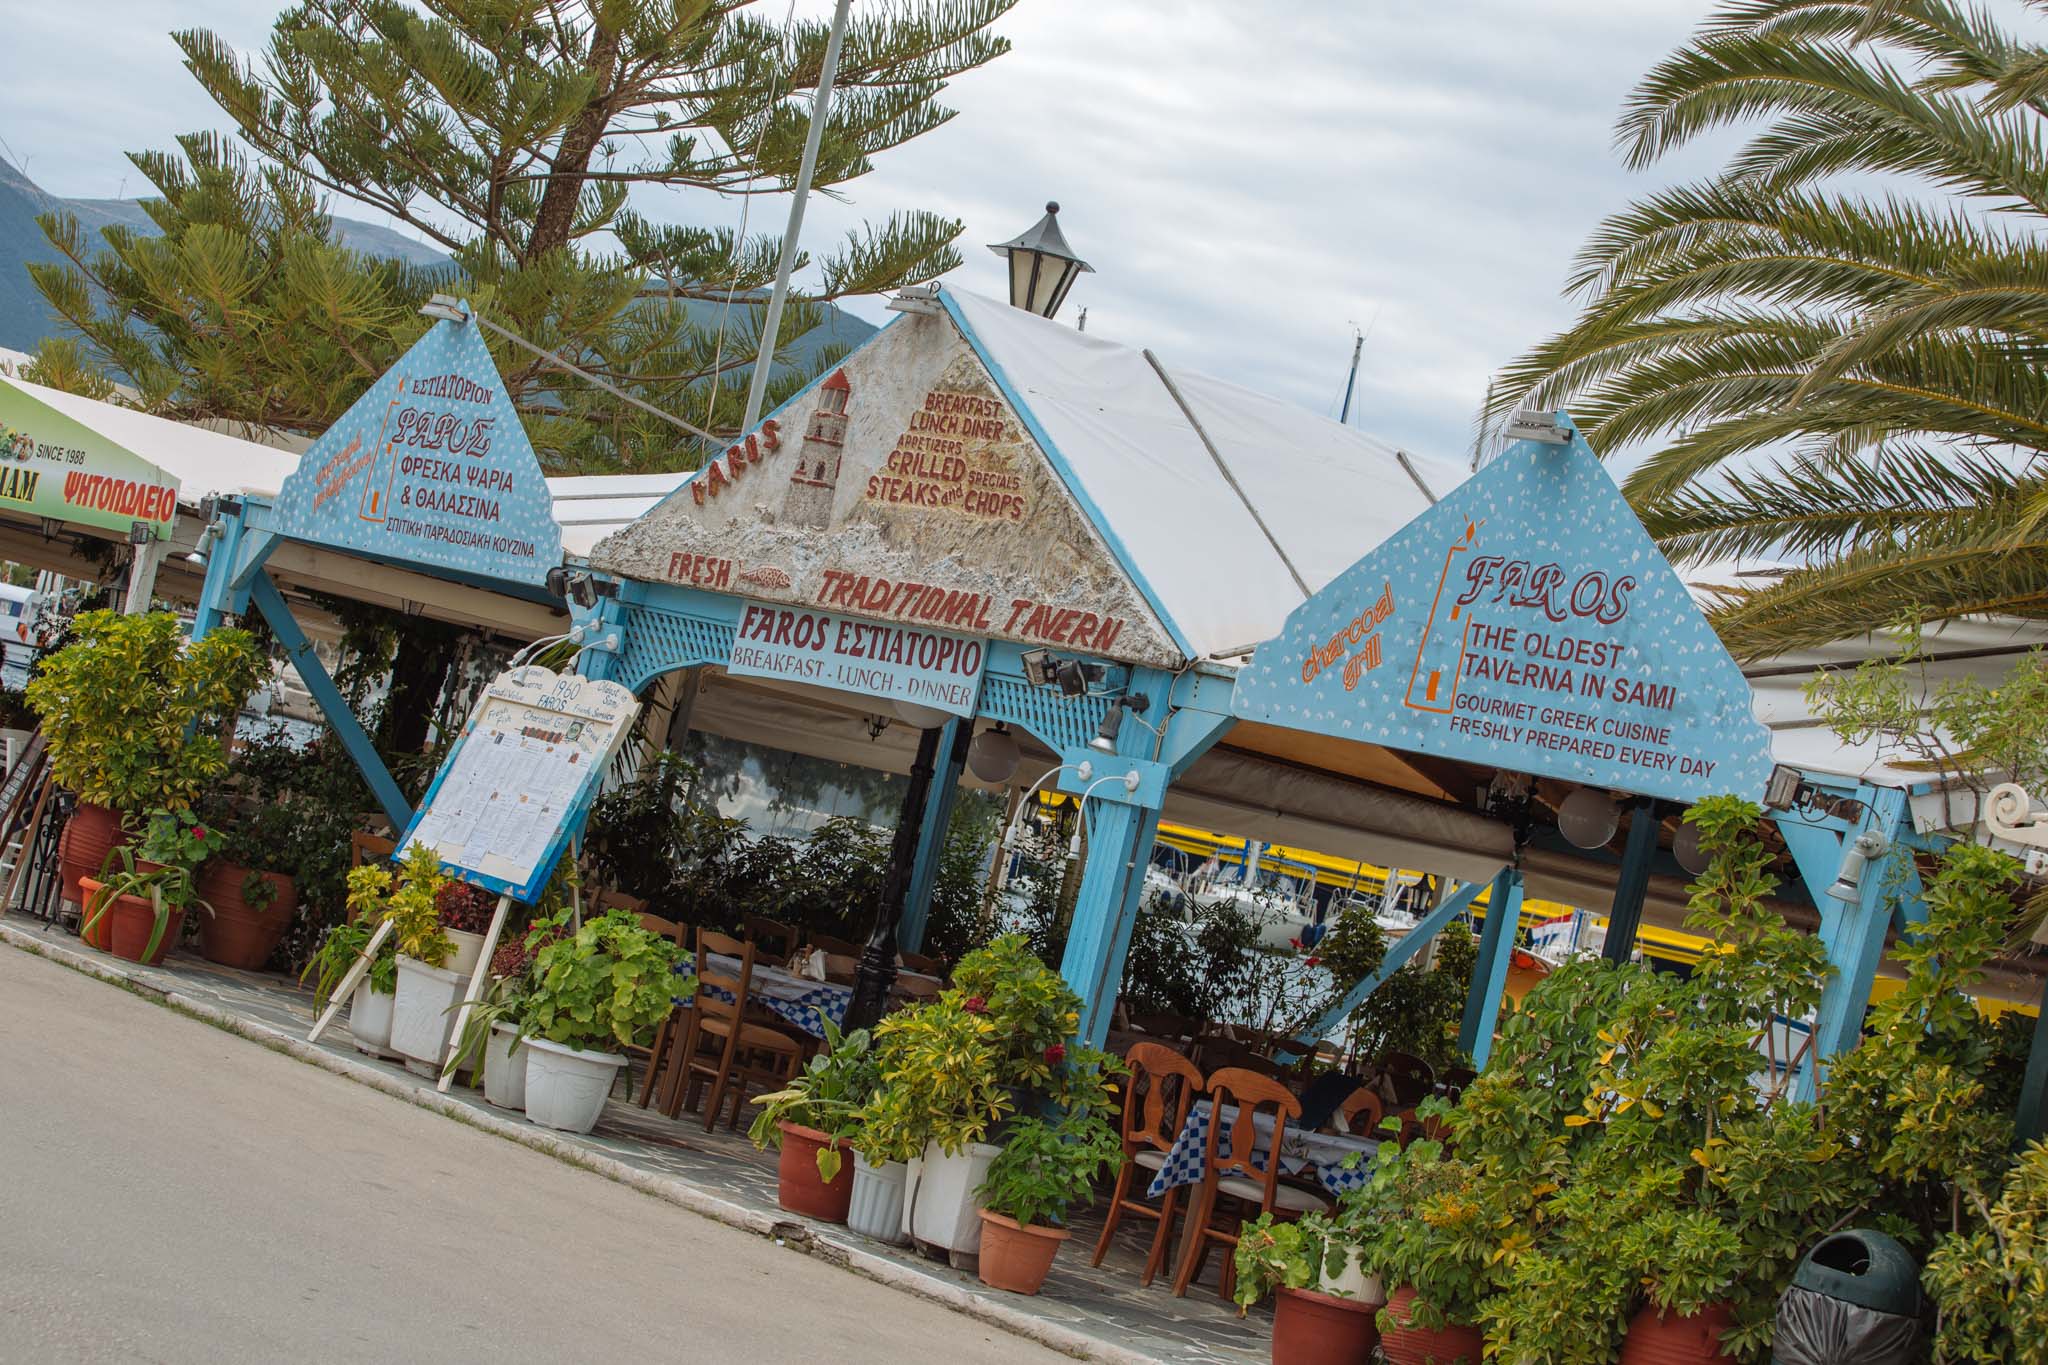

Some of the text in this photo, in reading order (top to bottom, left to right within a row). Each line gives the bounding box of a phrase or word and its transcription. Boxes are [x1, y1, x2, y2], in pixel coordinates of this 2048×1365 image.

[412, 374, 494, 405] ΕΣΤΙΑΤΟΡΙΟΝ
[924, 392, 1003, 418] BREAKFAST
[896, 433, 963, 455] APPETIZERS
[910, 411, 1005, 442] LUNCH DINER
[36, 443, 86, 465] SINCE 1988
[401, 455, 513, 493] ΦΡΕΣΚΑ ΨΑΡΙΑ
[888, 450, 1022, 491] GRILLED SPECIALS
[64, 470, 176, 523] ΨΗΤΟΠΩΛΕΙΟ
[401, 485, 500, 522] & ΘΑΛΑΣΣΙΝΑ
[866, 475, 1025, 520] STEAKS and CHOPS
[386, 517, 535, 558] ΣΠΙΤΙΚΗ ΠΑΡΑΔΟΣΙΑΚΗ ΚΟΥΖΙΝΑ
[667, 552, 732, 587] FRESH
[1456, 556, 1637, 625] FAROS
[816, 570, 1125, 650] TRADITIONAL TAVERN
[738, 605, 984, 677] FAROS ΕΣΤΙΑΤΟΡΙΟ
[1302, 582, 1396, 684] charcoal
[1471, 623, 1625, 670] THE OLDEST
[732, 647, 972, 707] BREAKFAST LUNCH DINNER
[1342, 633, 1385, 692] grill
[1465, 653, 1678, 712] TAVERNA IN SAMI
[537, 694, 568, 712] FAROS
[552, 680, 582, 700] 1960
[1455, 693, 1671, 746] GOURMET GREEK CUISINE
[1450, 716, 1716, 779] FRESHLY PREPARED EVERY DAY
